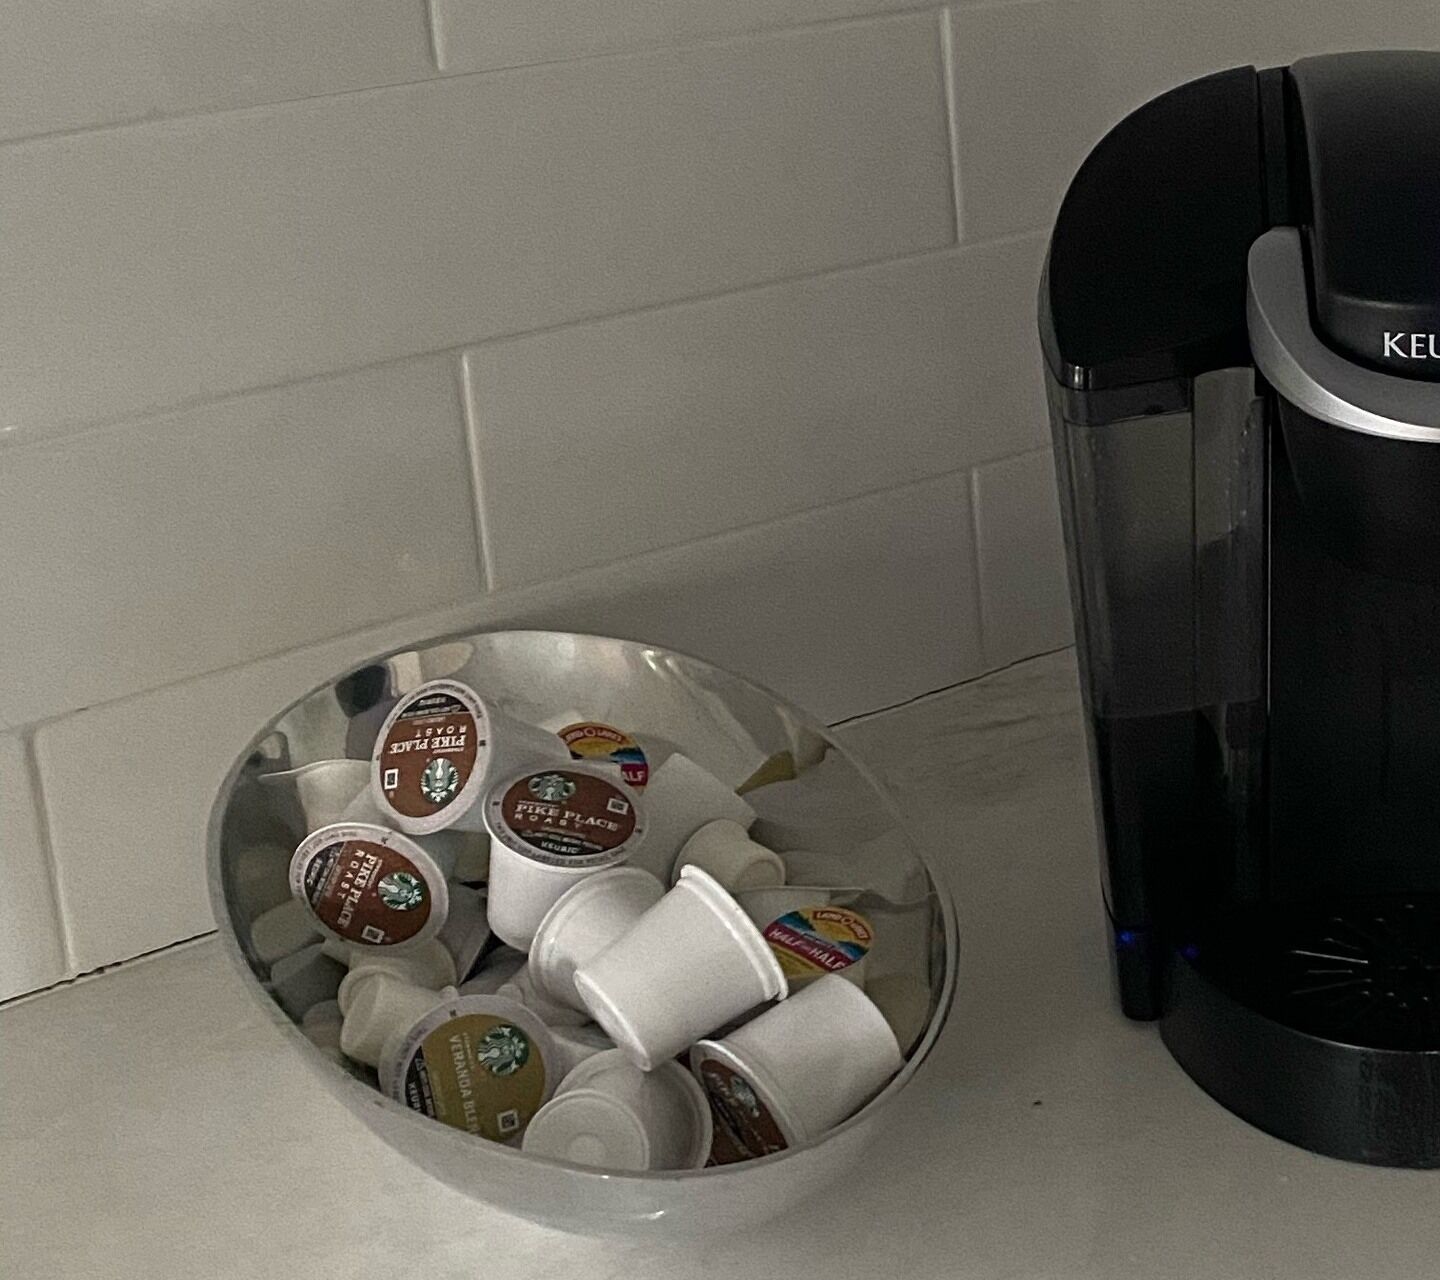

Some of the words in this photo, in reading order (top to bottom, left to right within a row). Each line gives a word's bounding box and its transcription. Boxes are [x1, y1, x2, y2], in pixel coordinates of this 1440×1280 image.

[390, 738, 428, 754] PLACE
[415, 725, 467, 737] ROAST
[431, 734, 467, 748] PIKE
[514, 812, 581, 829] ROAST
[515, 803, 559, 817] PIKE
[564, 810, 619, 832] PLACE
[337, 849, 365, 899] ROAST
[354, 853, 379, 888] PIKE
[337, 886, 363, 928] PLACE
[768, 927, 802, 947] HALF
[809, 947, 847, 970] HALF
[449, 1034, 474, 1099] VERANDA
[463, 1099, 480, 1137] BLEN
